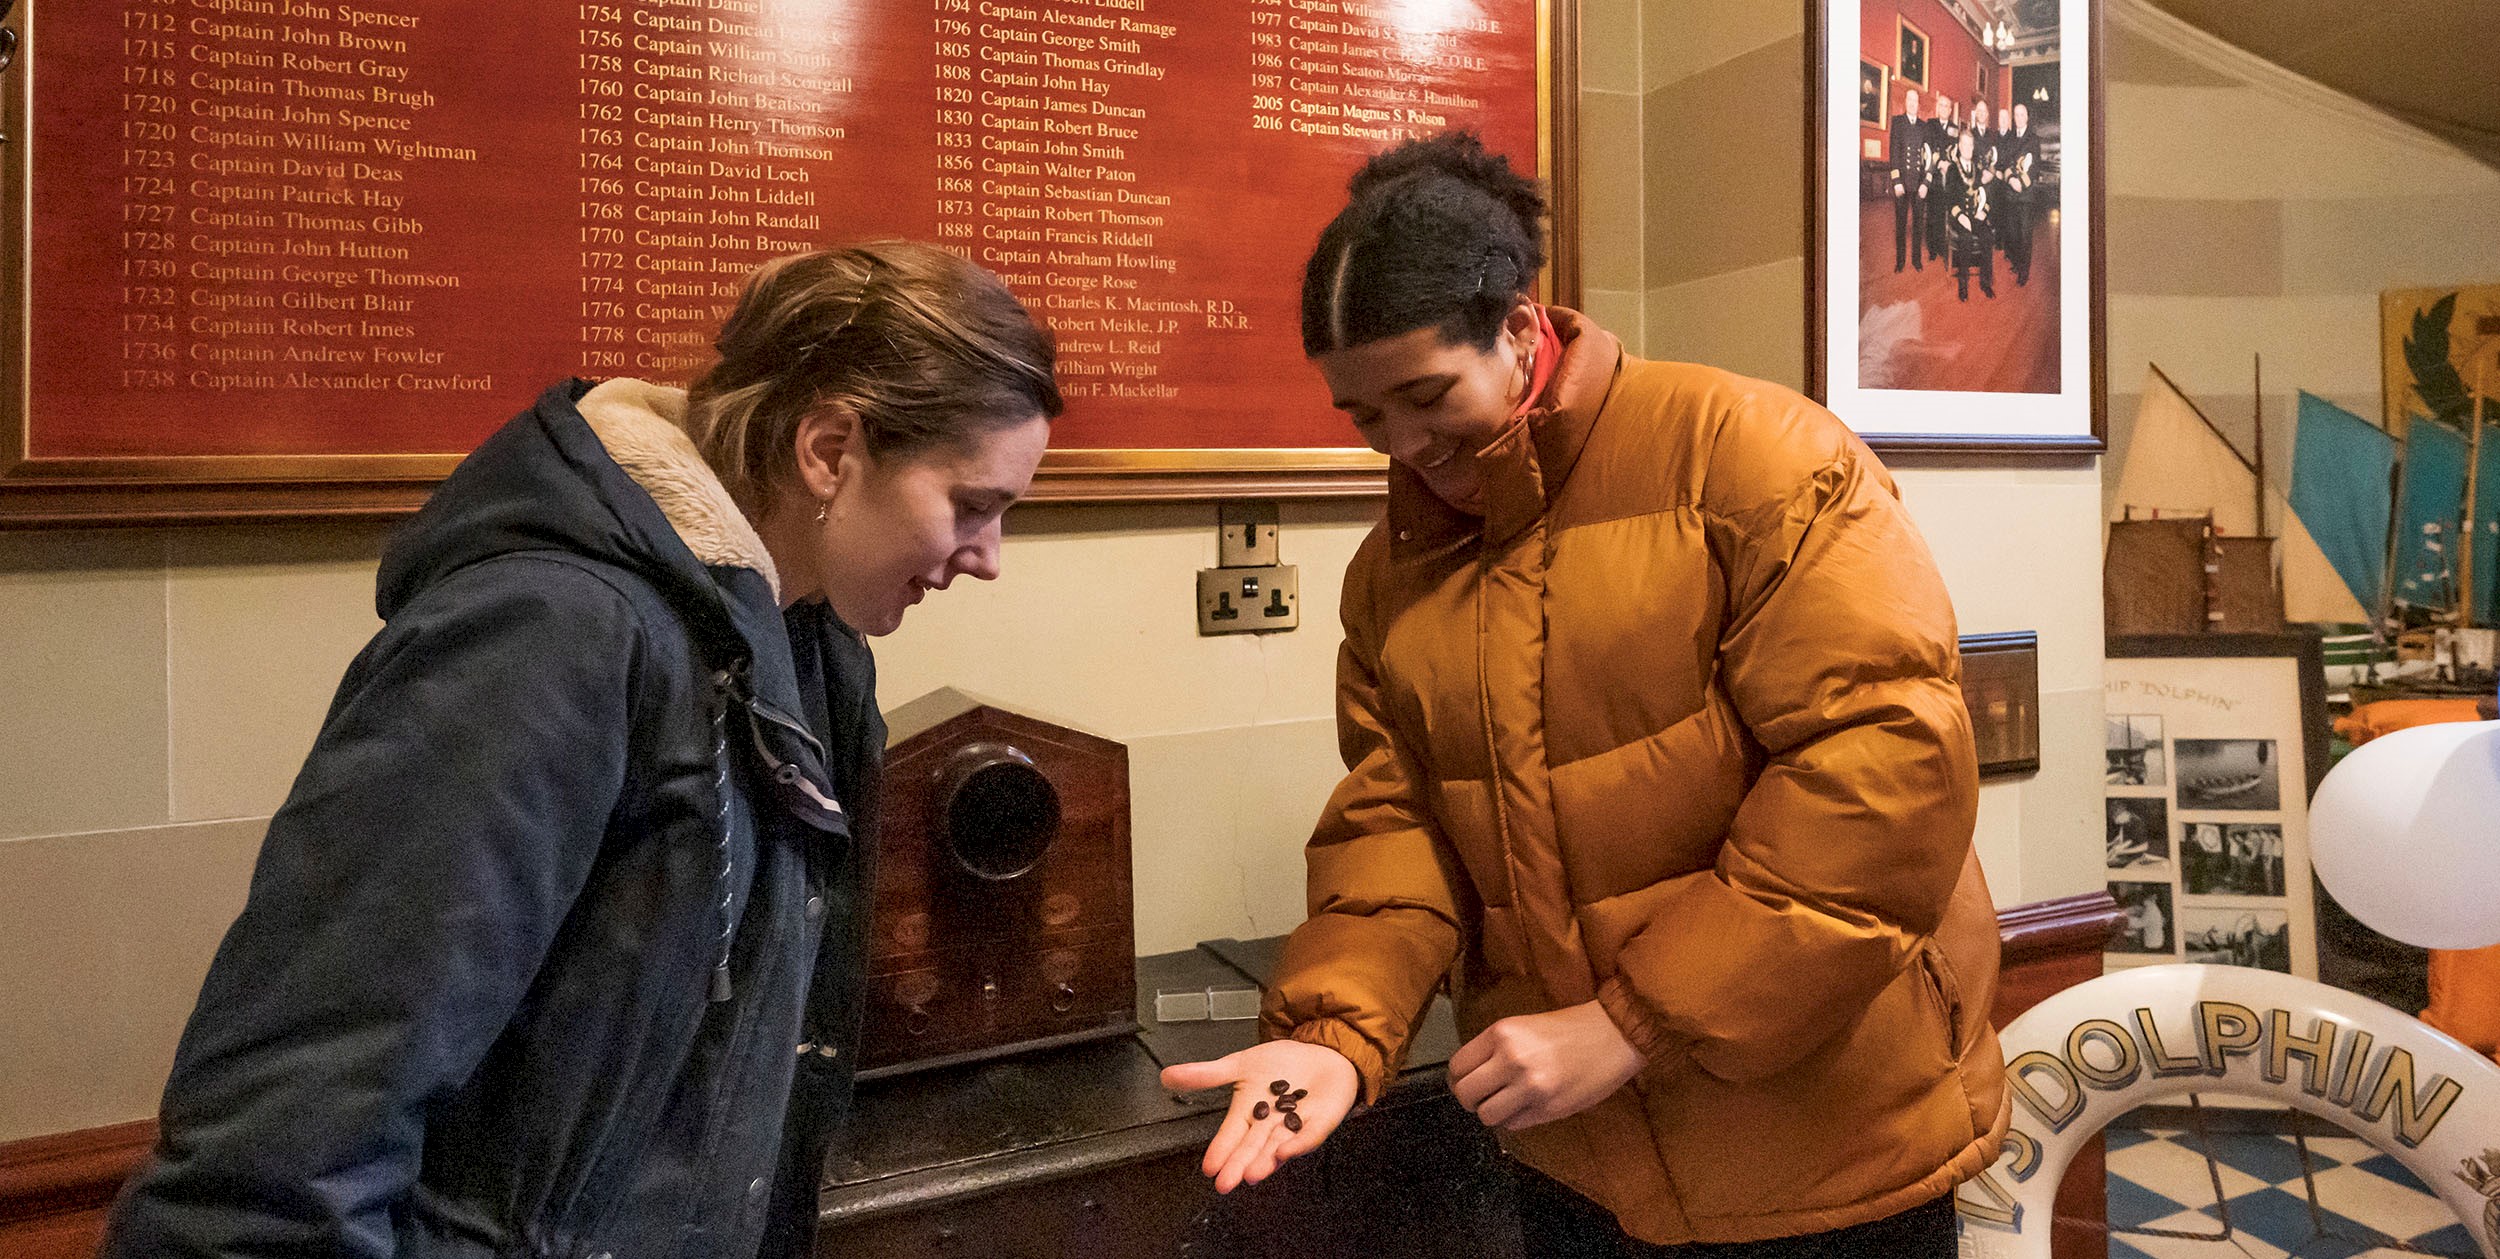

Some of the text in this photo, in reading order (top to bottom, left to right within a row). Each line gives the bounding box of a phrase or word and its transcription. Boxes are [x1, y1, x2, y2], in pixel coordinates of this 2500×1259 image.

[282, 0, 330, 19] John
[338, 6, 419, 28] Spencer
[935, 0, 1176, 38] 1794 Captain Alexander Ramage
[1252, 11, 1281, 26] 1977
[1289, 16, 1338, 33] Captain
[1342, 22, 1378, 37] David
[124, 11, 406, 52] 1712 Captain John Brown
[935, 19, 1140, 53] 1796 Captain George Smith
[125, 38, 408, 82] 1715 Captain Robert Gray
[580, 30, 622, 47] 1756
[634, 34, 701, 55] Captain
[708, 42, 776, 62] William
[580, 54, 622, 72] 1758
[634, 59, 702, 80] Captain
[709, 66, 774, 85] Richard
[936, 42, 1165, 80] 1805 Captain Thomas Grindlay
[1252, 53, 1282, 67] 1986
[1290, 57, 1338, 74] Captain
[1343, 63, 1383, 78] Seaton
[125, 67, 434, 110] 1718 Captain Thomas Brugh
[581, 79, 824, 112] 1760 Captain John Beatson
[936, 87, 1145, 118] 1820 Captain James Duncan
[1252, 74, 1282, 88] 1987
[1290, 77, 1338, 95] Captain
[1343, 83, 1405, 100] Alexander
[1425, 89, 1479, 108] Hamilton
[581, 104, 845, 139] 1762 Captain Henry Thomson
[1253, 95, 1283, 110] 2005
[1290, 99, 1339, 117] Captain
[1343, 104, 1389, 122] Magnus
[1408, 110, 1446, 126] Polson
[125, 121, 476, 160] 1720 Captain William Wightman
[1253, 115, 1282, 130] 2016
[1290, 119, 1339, 136] Captain
[1343, 123, 1387, 140] Stewart
[581, 153, 808, 182] 1764 Captain David Loch
[937, 155, 1135, 182] 1856 Captain Walter Paton
[125, 177, 403, 211] 1724 Captain Patrick Hay
[581, 178, 814, 206] 1766 Captain John Liddell
[938, 177, 1170, 205] 1868 Captain Sebastian Duncan
[124, 204, 423, 234] 1727 Captain Thomas Gibb
[938, 200, 1163, 226] 1873 Captain Robert Thomson
[124, 232, 408, 259] 1728 Captain John Hutton
[582, 227, 812, 252] 1770 Captain John Brown
[938, 223, 1152, 247] 1888 Captain Francis Riddell
[124, 259, 459, 287] 1730 Captain George Thomson
[582, 252, 623, 268] 1772
[636, 255, 704, 274] Captain
[983, 247, 1040, 265] Captain
[1047, 251, 1111, 266] Abraham
[1117, 253, 1176, 273] Howling
[1045, 272, 1098, 291] George
[1103, 275, 1137, 289] Rose
[583, 302, 624, 317] 1776
[636, 303, 704, 323] Captain
[1046, 294, 1100, 309] Charles
[124, 315, 414, 338] 1734 Captain Robert Innes
[1048, 317, 1094, 331] Robert
[1057, 340, 1103, 353] ndrew
[1129, 340, 1160, 354] Reid
[1110, 362, 1157, 378] Wright
[1059, 383, 1087, 396] olin
[1110, 383, 1179, 398] Mackellar
[2004, 1001, 2463, 1147] DOLPHIN
